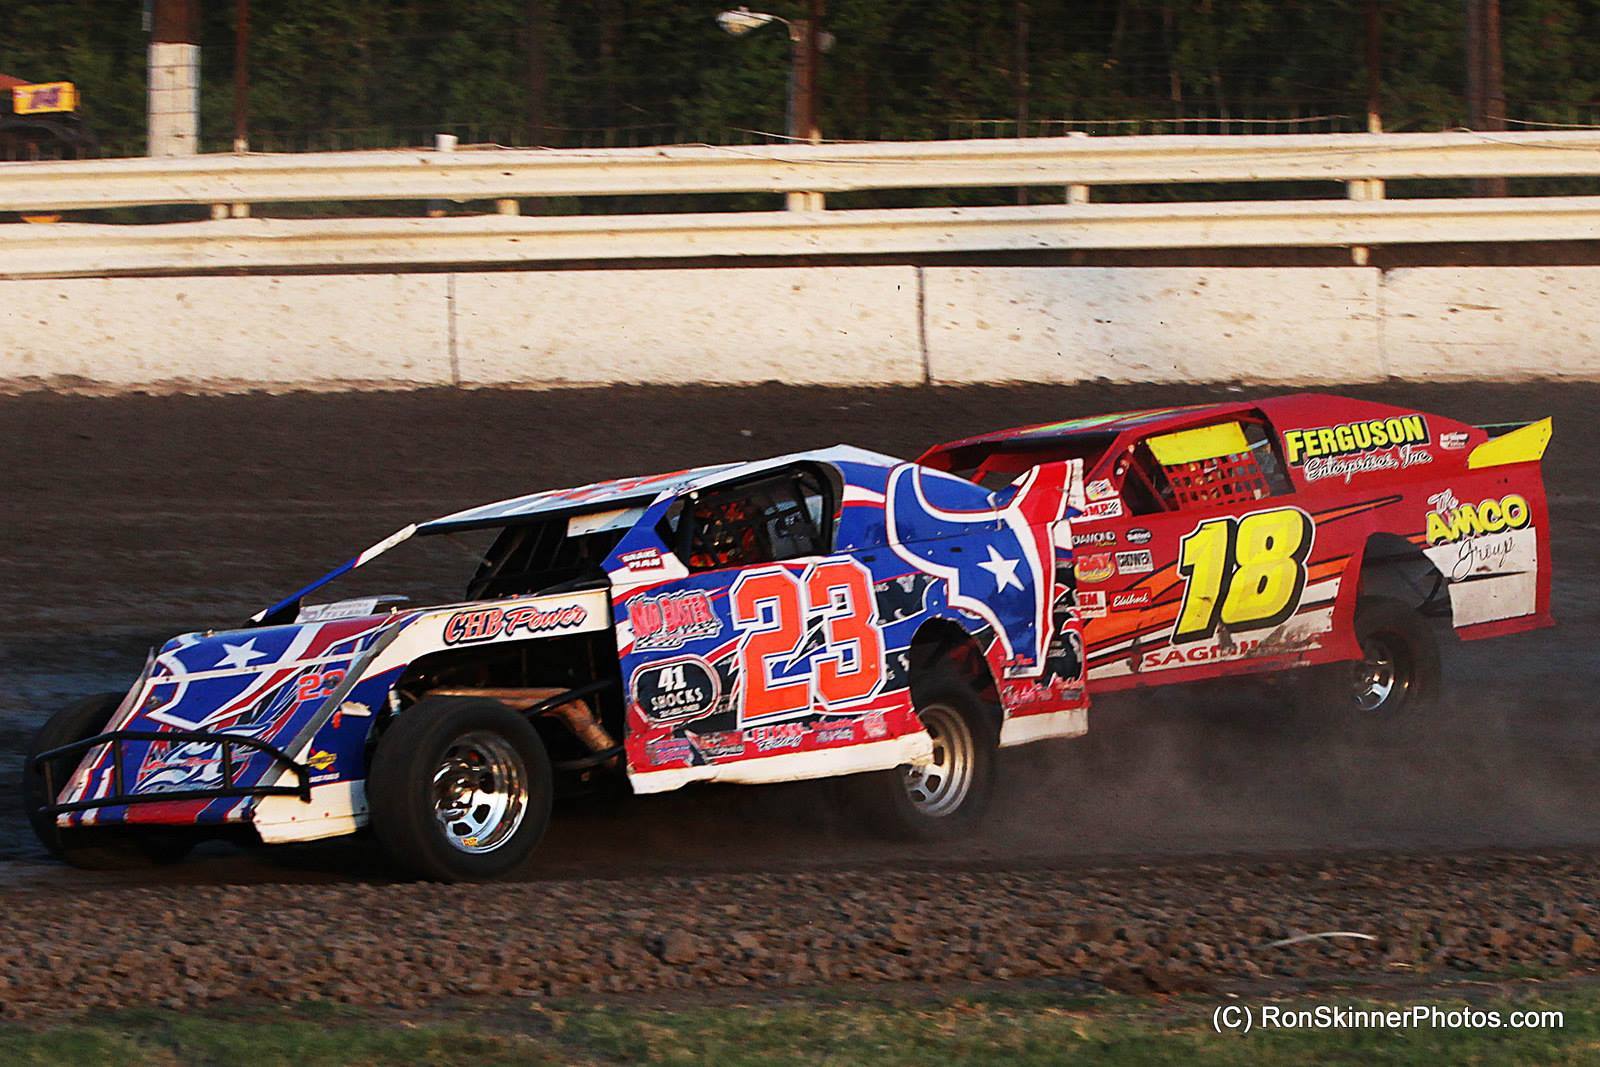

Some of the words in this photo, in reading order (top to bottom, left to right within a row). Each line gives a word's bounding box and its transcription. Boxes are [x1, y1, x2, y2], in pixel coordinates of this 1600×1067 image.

[1284, 414, 1430, 467] FERGUSON
[1304, 451, 1399, 484] Enterprises,
[1399, 444, 1433, 468] Inc.
[1426, 494, 1532, 546] AMCO
[1427, 488, 1459, 512] The
[1170, 506, 1316, 645] 18
[1452, 537, 1515, 582] Group
[443, 608, 504, 646] CHB
[504, 605, 588, 636] Power
[729, 555, 886, 728] 23
[651, 688, 703, 711] SHOCKS
[658, 665, 687, 692] 41
